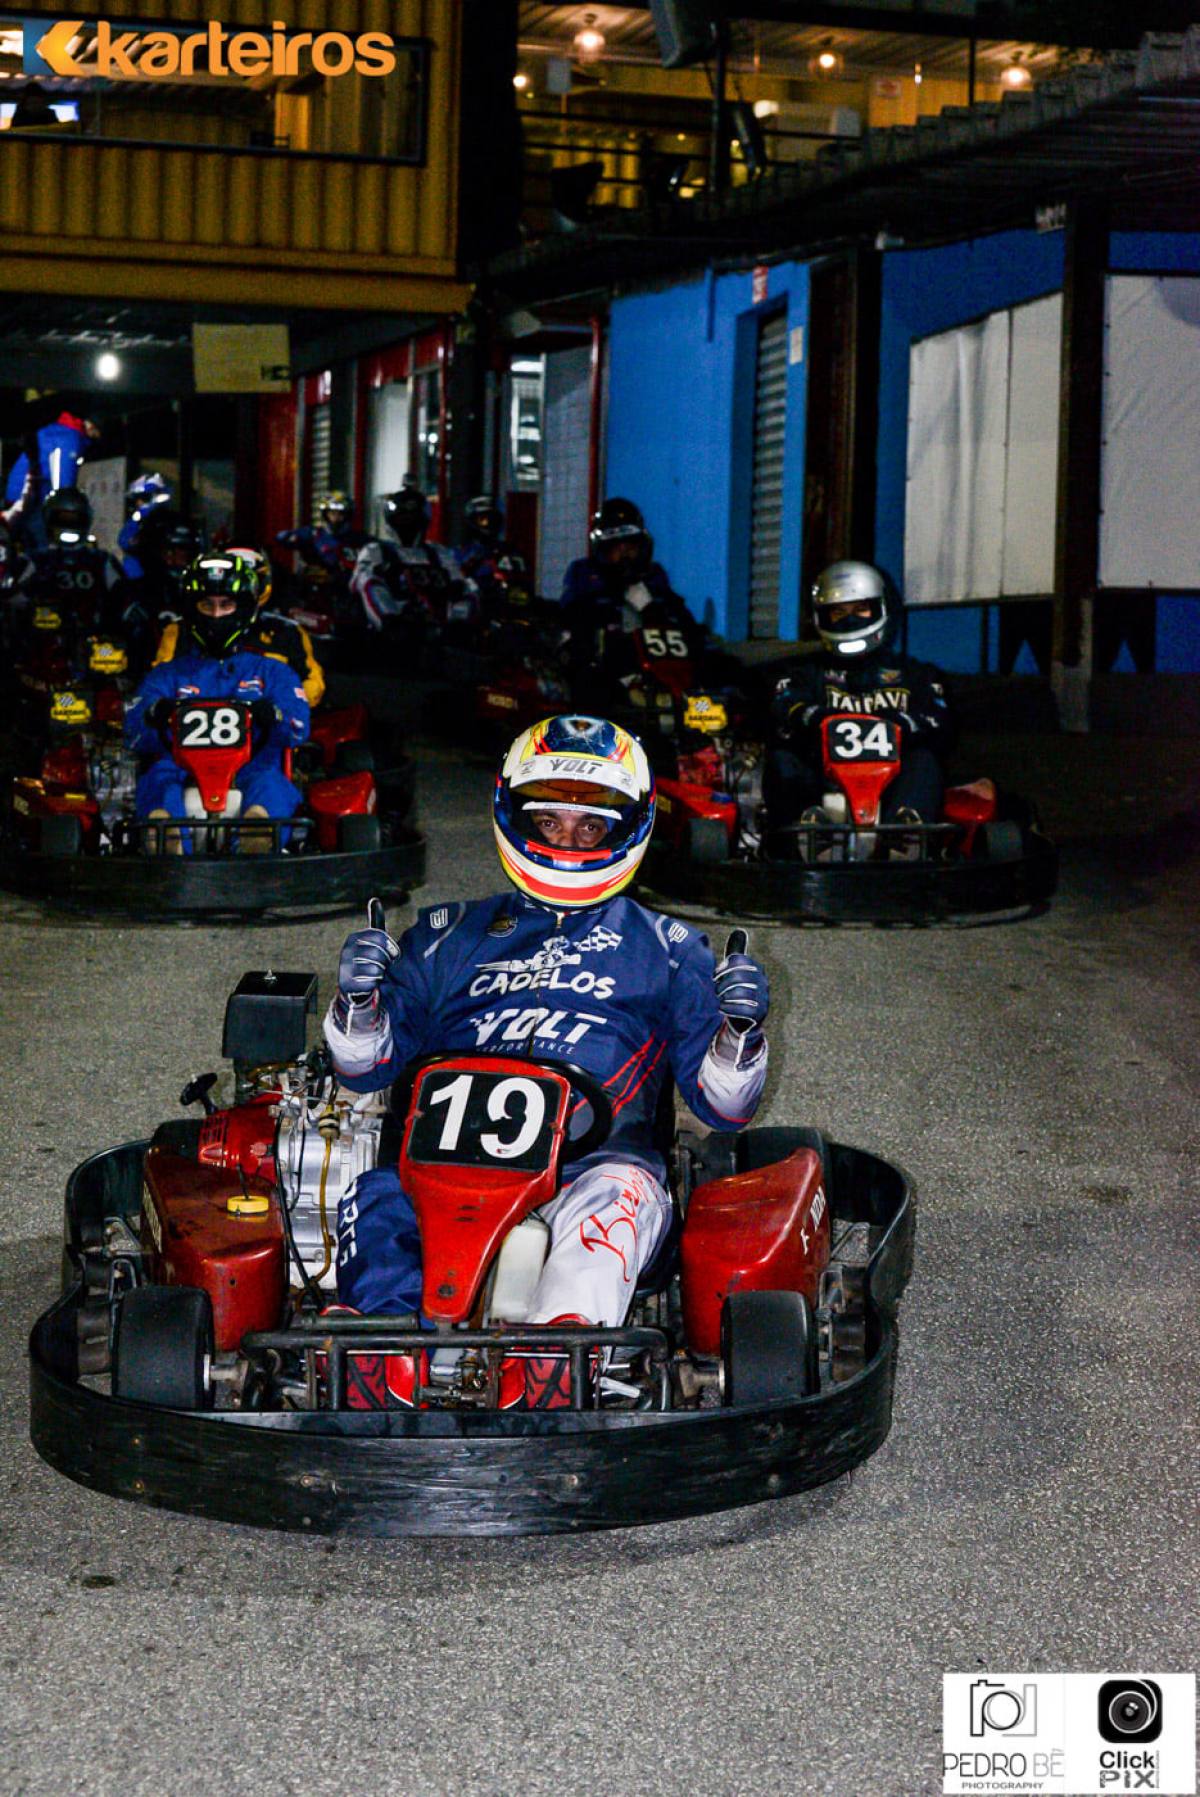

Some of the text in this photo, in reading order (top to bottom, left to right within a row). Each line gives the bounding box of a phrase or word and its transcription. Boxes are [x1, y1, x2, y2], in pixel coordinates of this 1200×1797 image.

[643, 629, 688, 658] 55
[182, 708, 241, 746] 28
[834, 721, 893, 759] 34
[550, 758, 603, 775] VOLT
[469, 1007, 608, 1046] VOLT
[430, 1074, 546, 1159] 19
